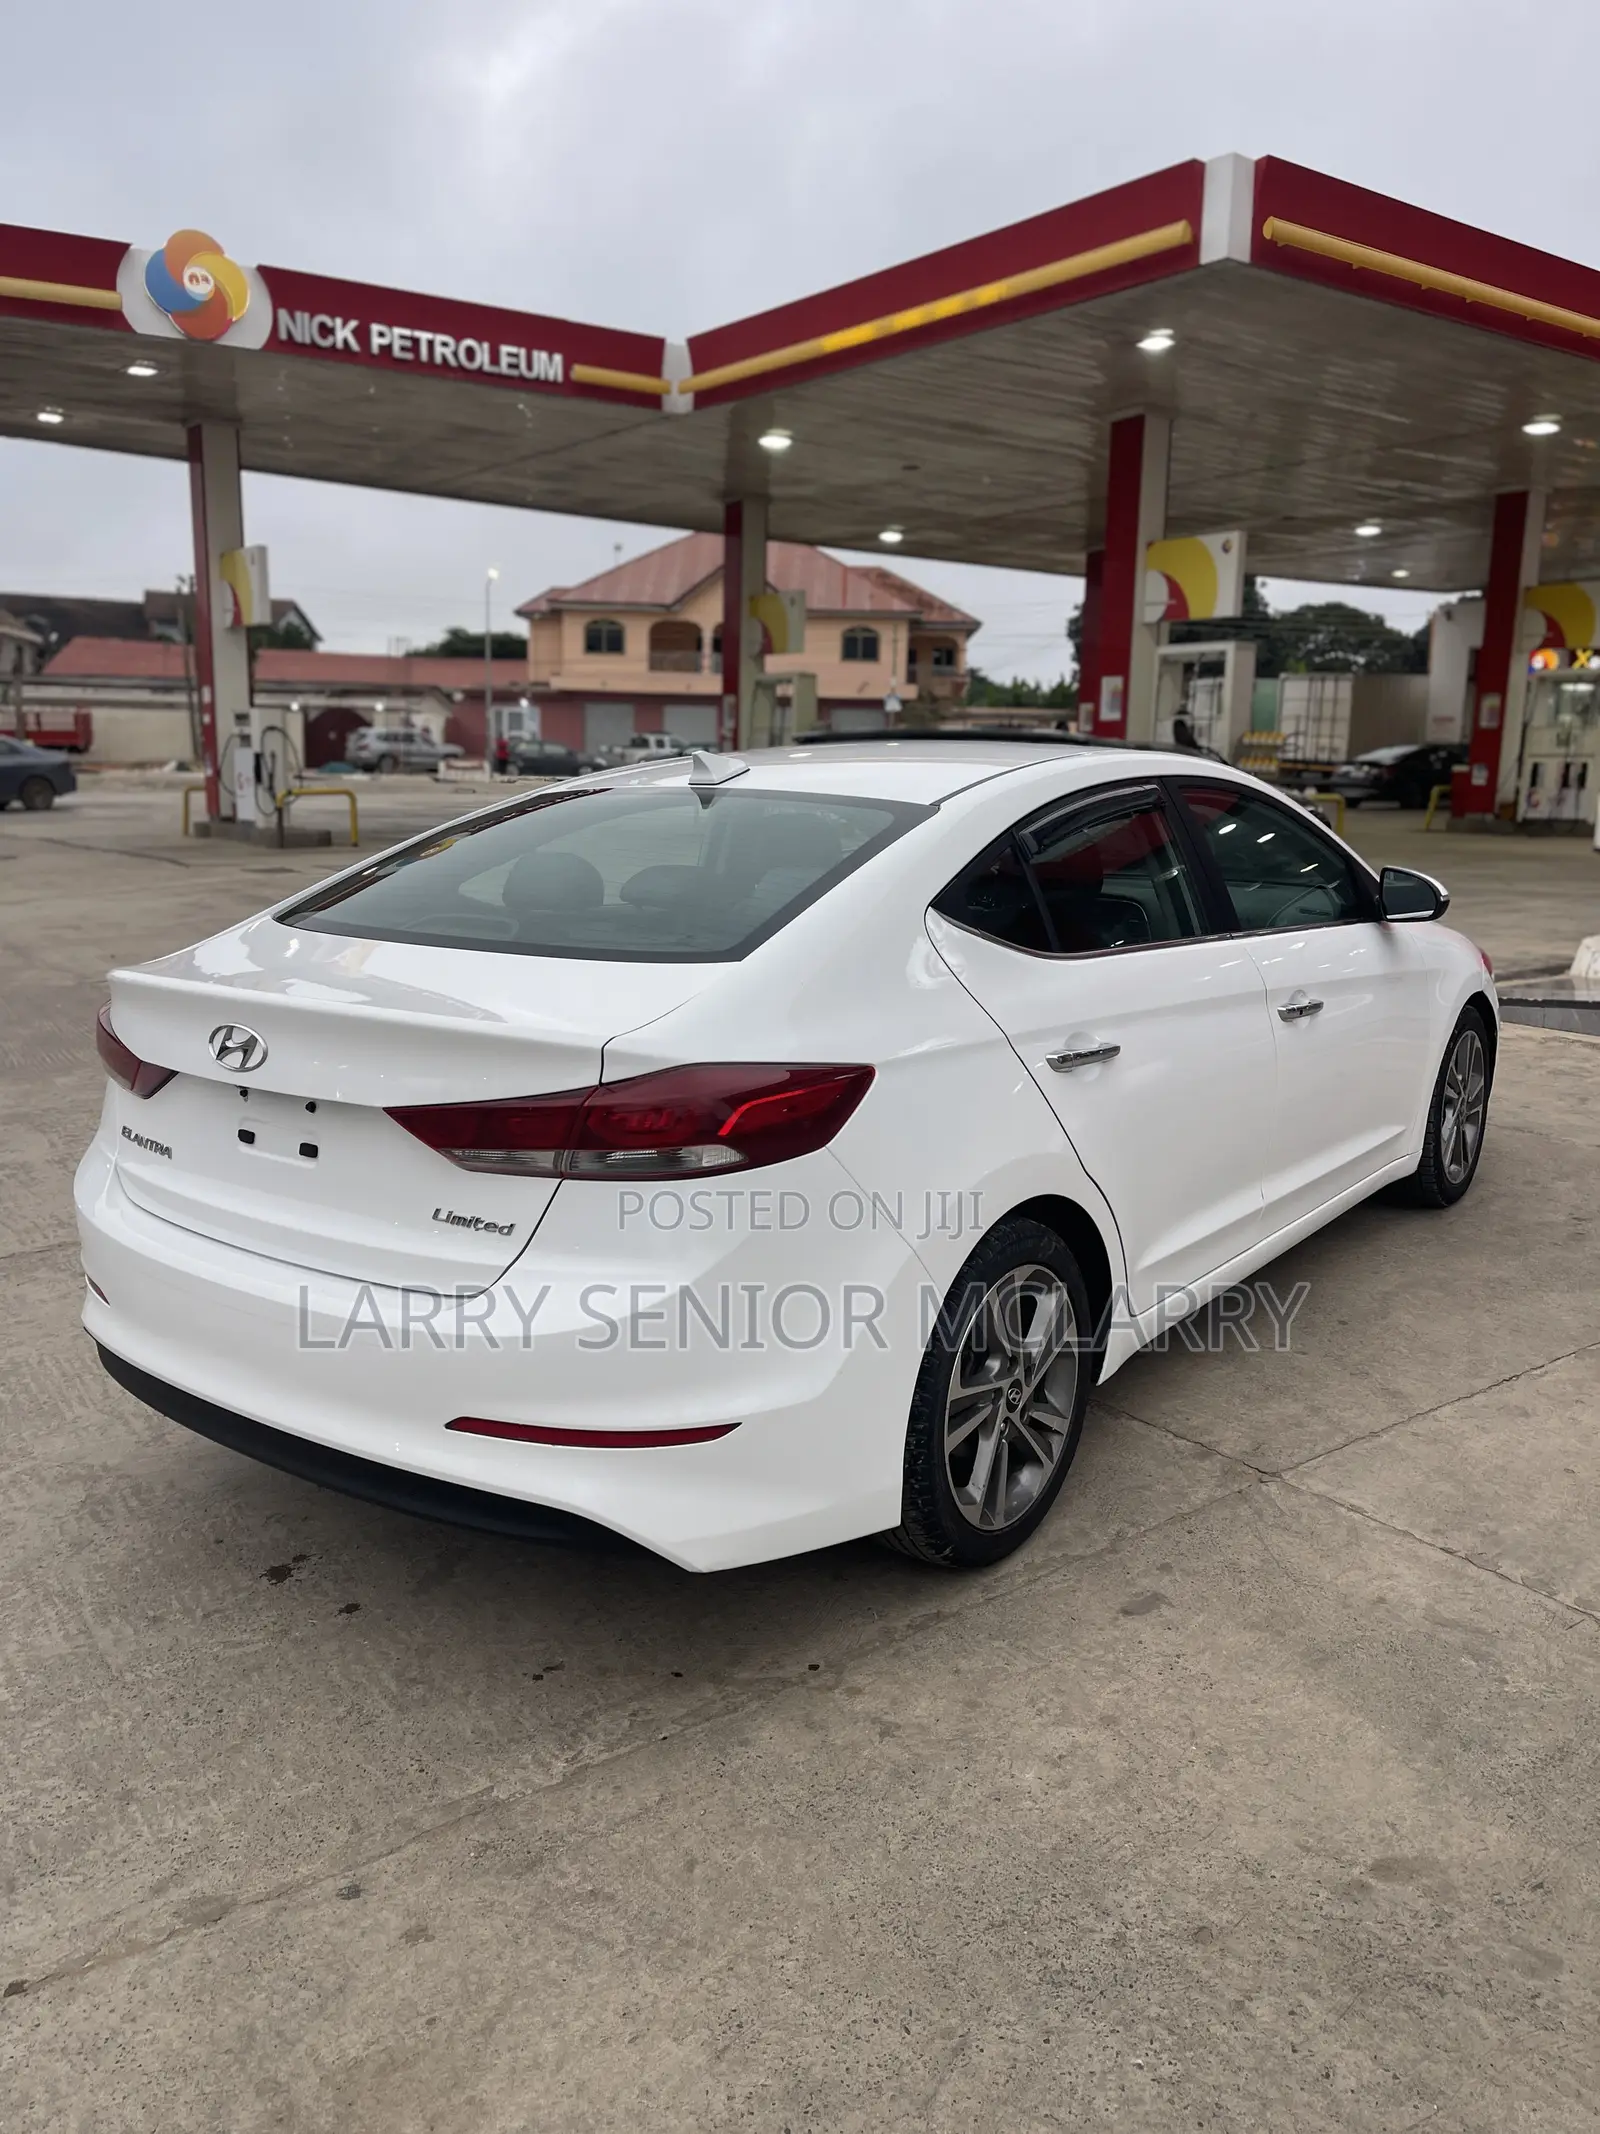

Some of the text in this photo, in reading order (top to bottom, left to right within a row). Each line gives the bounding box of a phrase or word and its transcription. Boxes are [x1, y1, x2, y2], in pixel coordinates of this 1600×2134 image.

[277, 308, 564, 384] NICK PETROLEUM
[121, 1125, 173, 1160] ELANTRA
[432, 1207, 516, 1237] Limited
